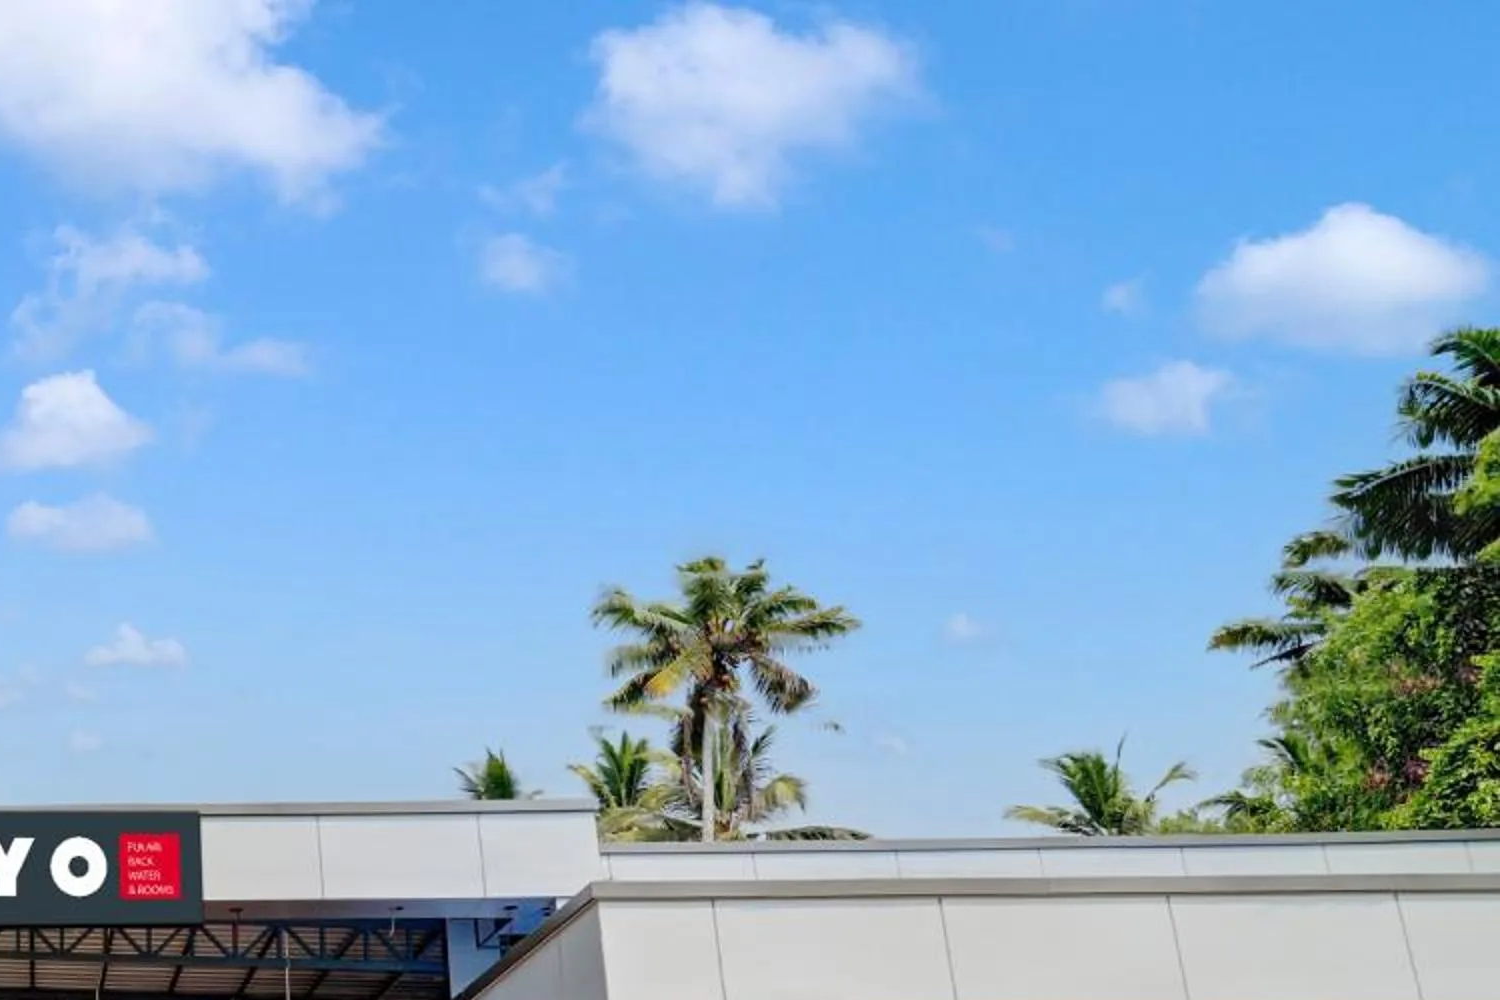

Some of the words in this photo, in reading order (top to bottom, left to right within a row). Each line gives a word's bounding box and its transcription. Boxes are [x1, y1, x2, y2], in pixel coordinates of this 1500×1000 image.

[127, 855, 156, 867] BACK
[128, 869, 161, 881] WATER
[137, 883, 175, 895] ROOMS
